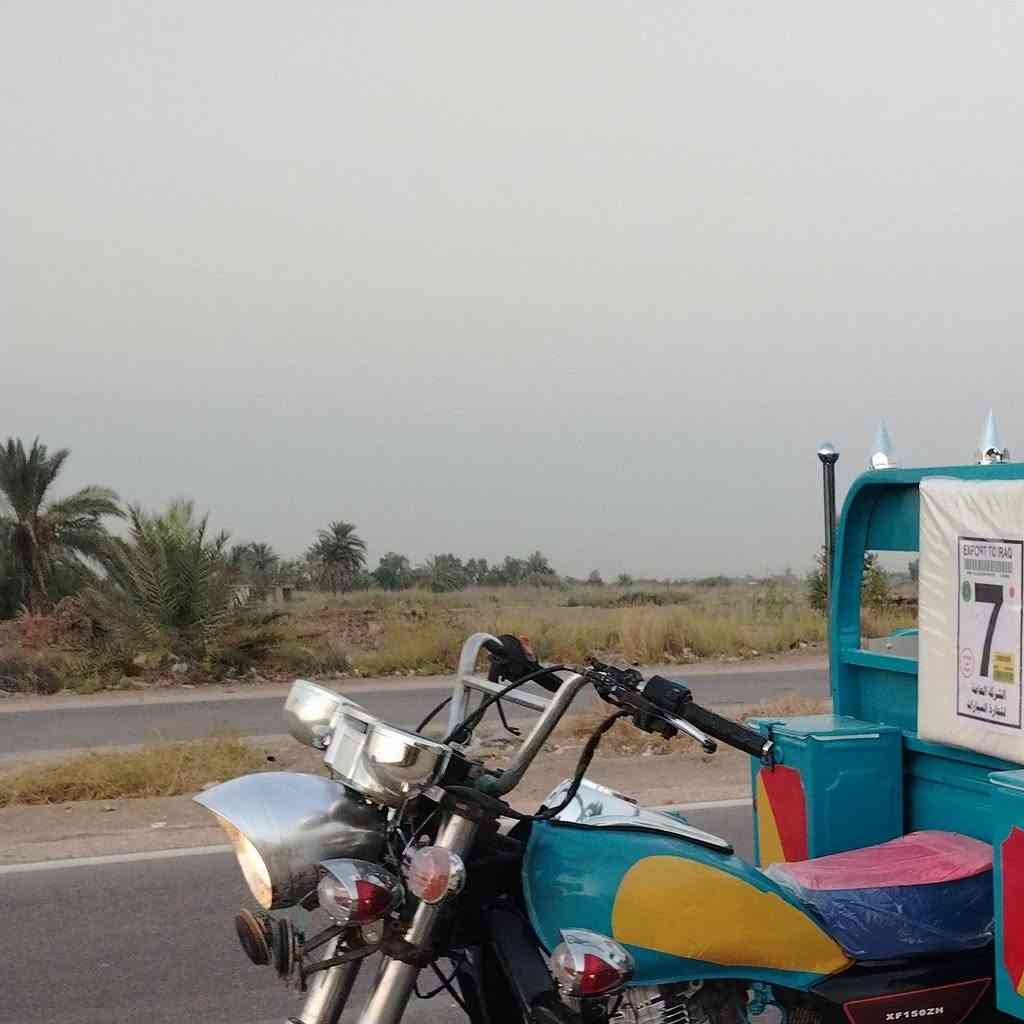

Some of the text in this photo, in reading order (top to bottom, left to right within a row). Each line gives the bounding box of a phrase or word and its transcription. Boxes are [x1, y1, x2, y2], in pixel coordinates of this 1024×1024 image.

[963, 544, 1013, 560] EXPORT TO IRAQ
[974, 582, 1004, 677] 7
[885, 1006, 944, 1020] XF150ZH
